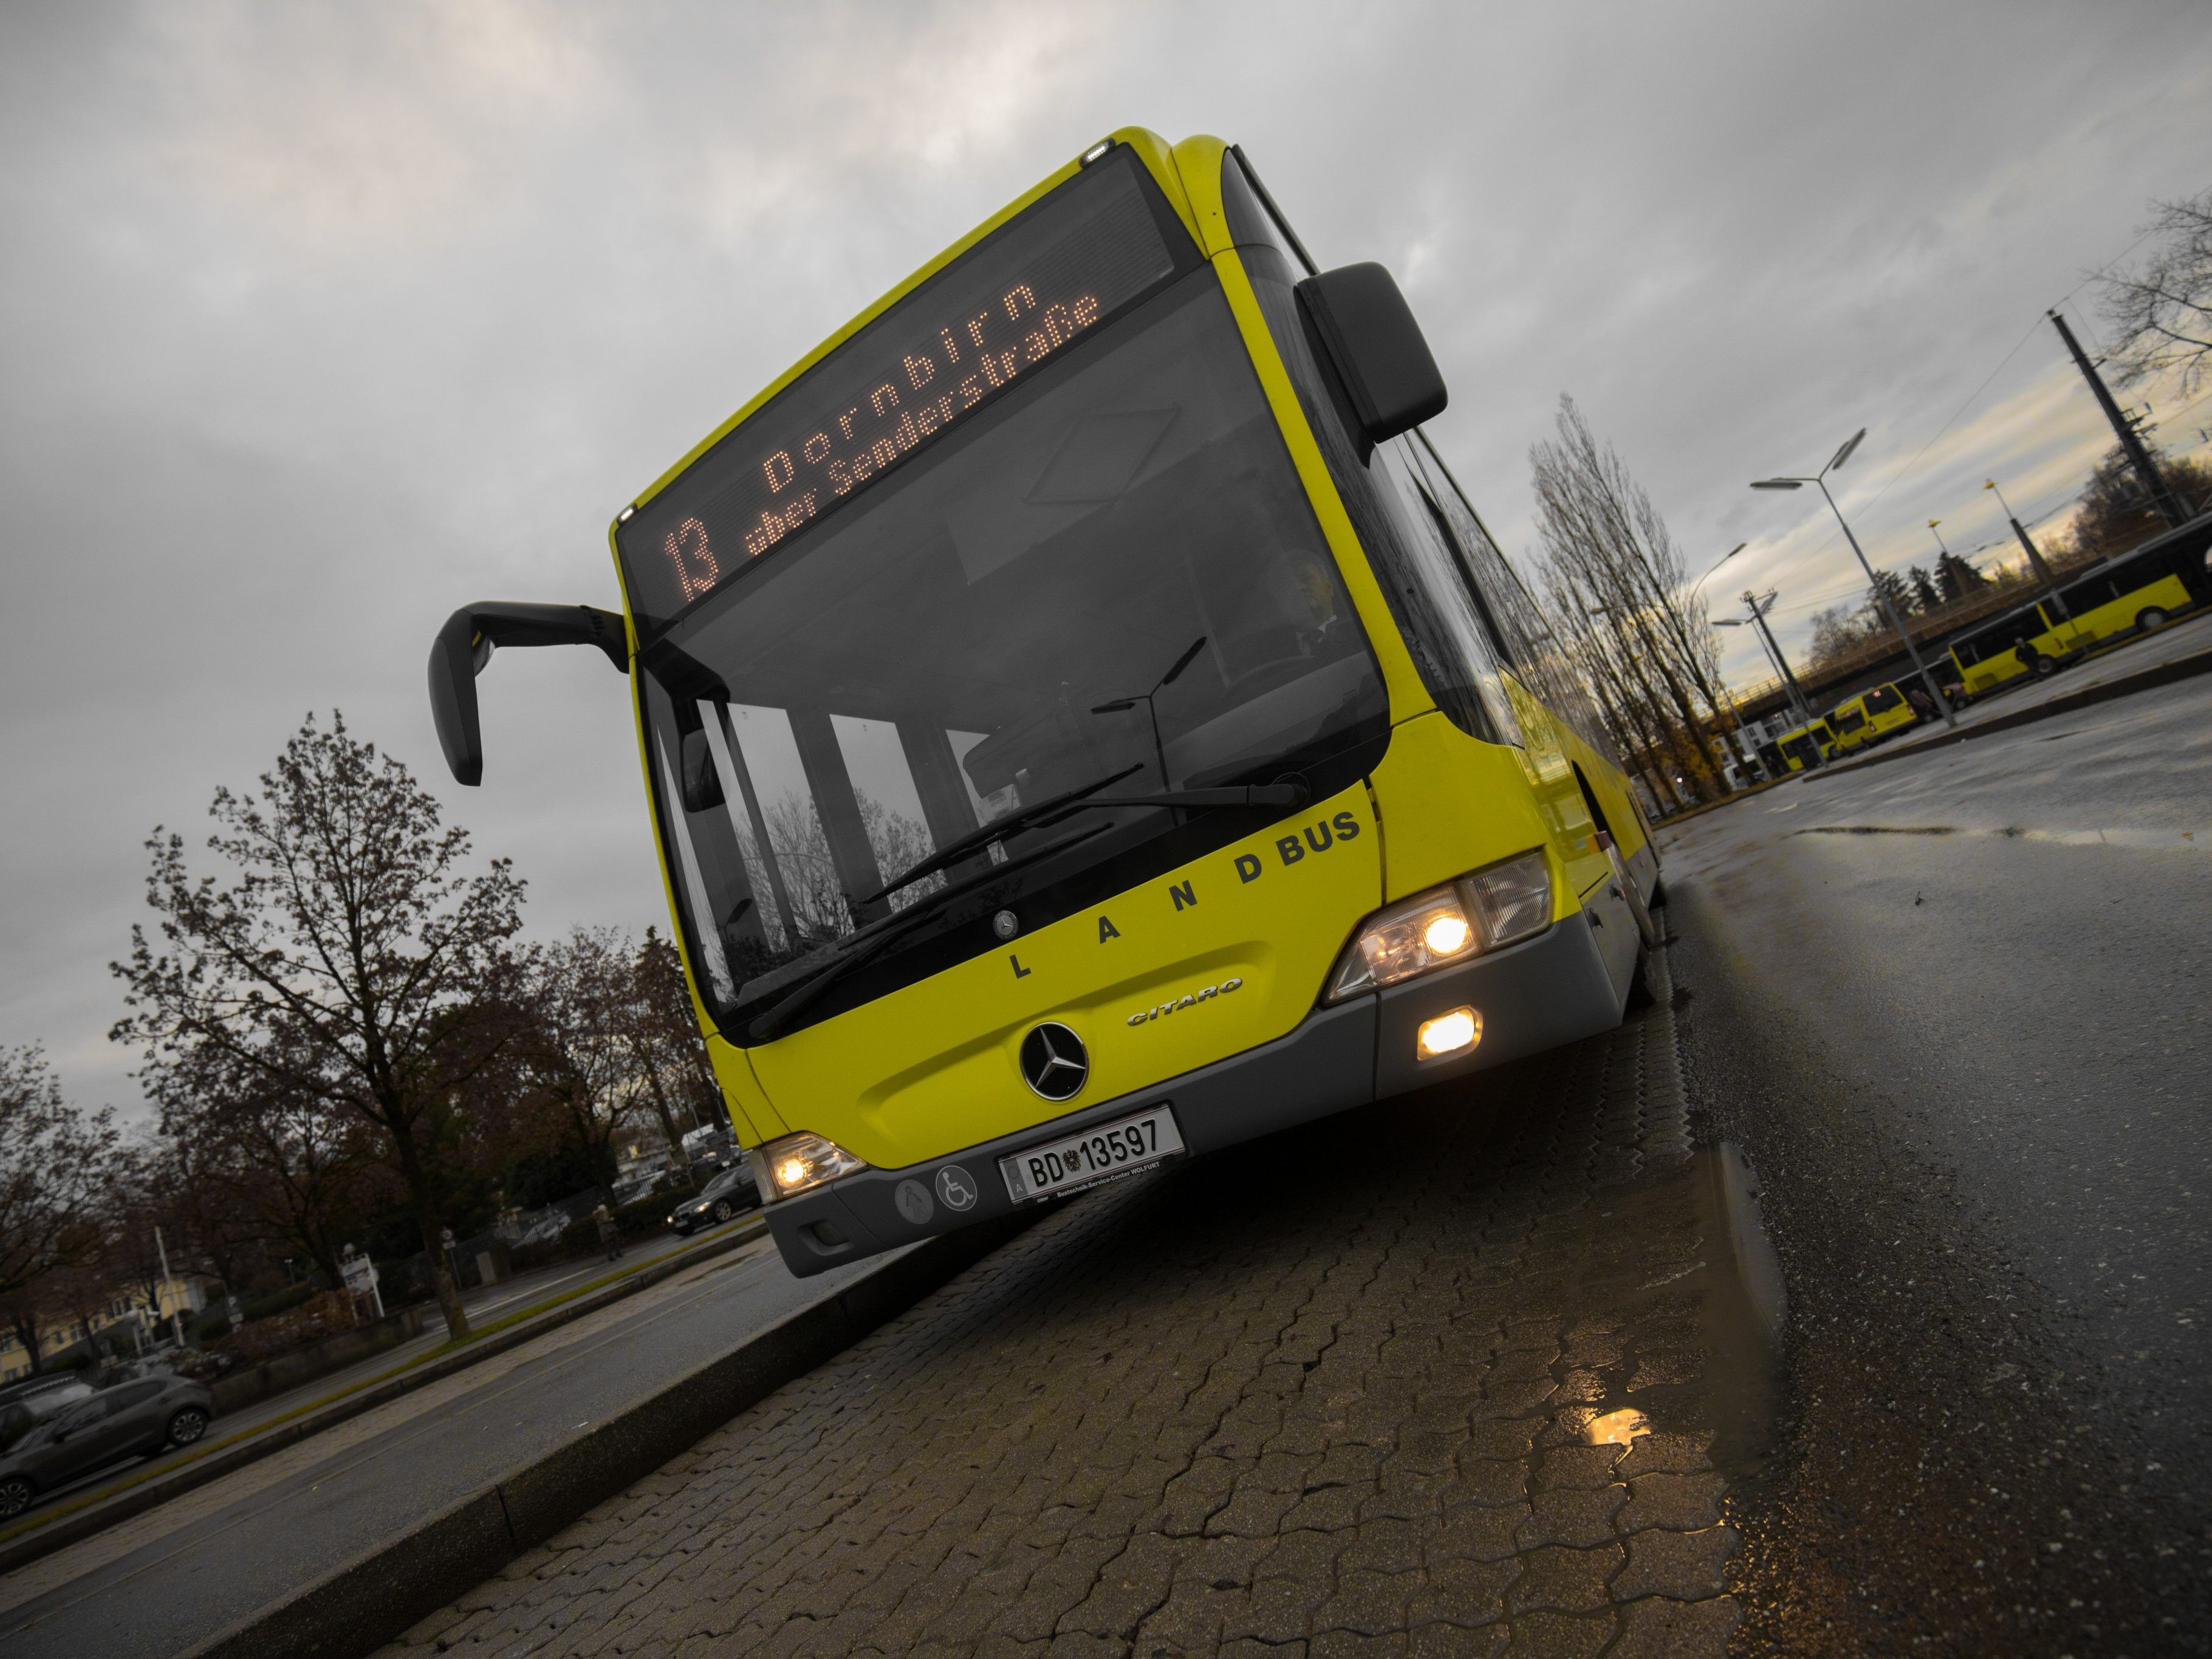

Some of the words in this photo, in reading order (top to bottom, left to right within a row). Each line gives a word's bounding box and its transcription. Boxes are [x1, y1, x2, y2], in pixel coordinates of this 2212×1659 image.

[763, 285, 1036, 493] Dornbirn
[745, 488, 817, 556] über
[829, 295, 1098, 496] Senderstraße
[663, 517, 719, 601] 13
[1127, 978, 1243, 1026] CITARO
[1028, 1152, 1064, 1187] BD
[1080, 1118, 1156, 1170] 13597
[1056, 1170, 1131, 1198] Bustechnik-Service-Center
[1131, 1160, 1160, 1176] WOLFURT
[1016, 1184, 1024, 1193] A
